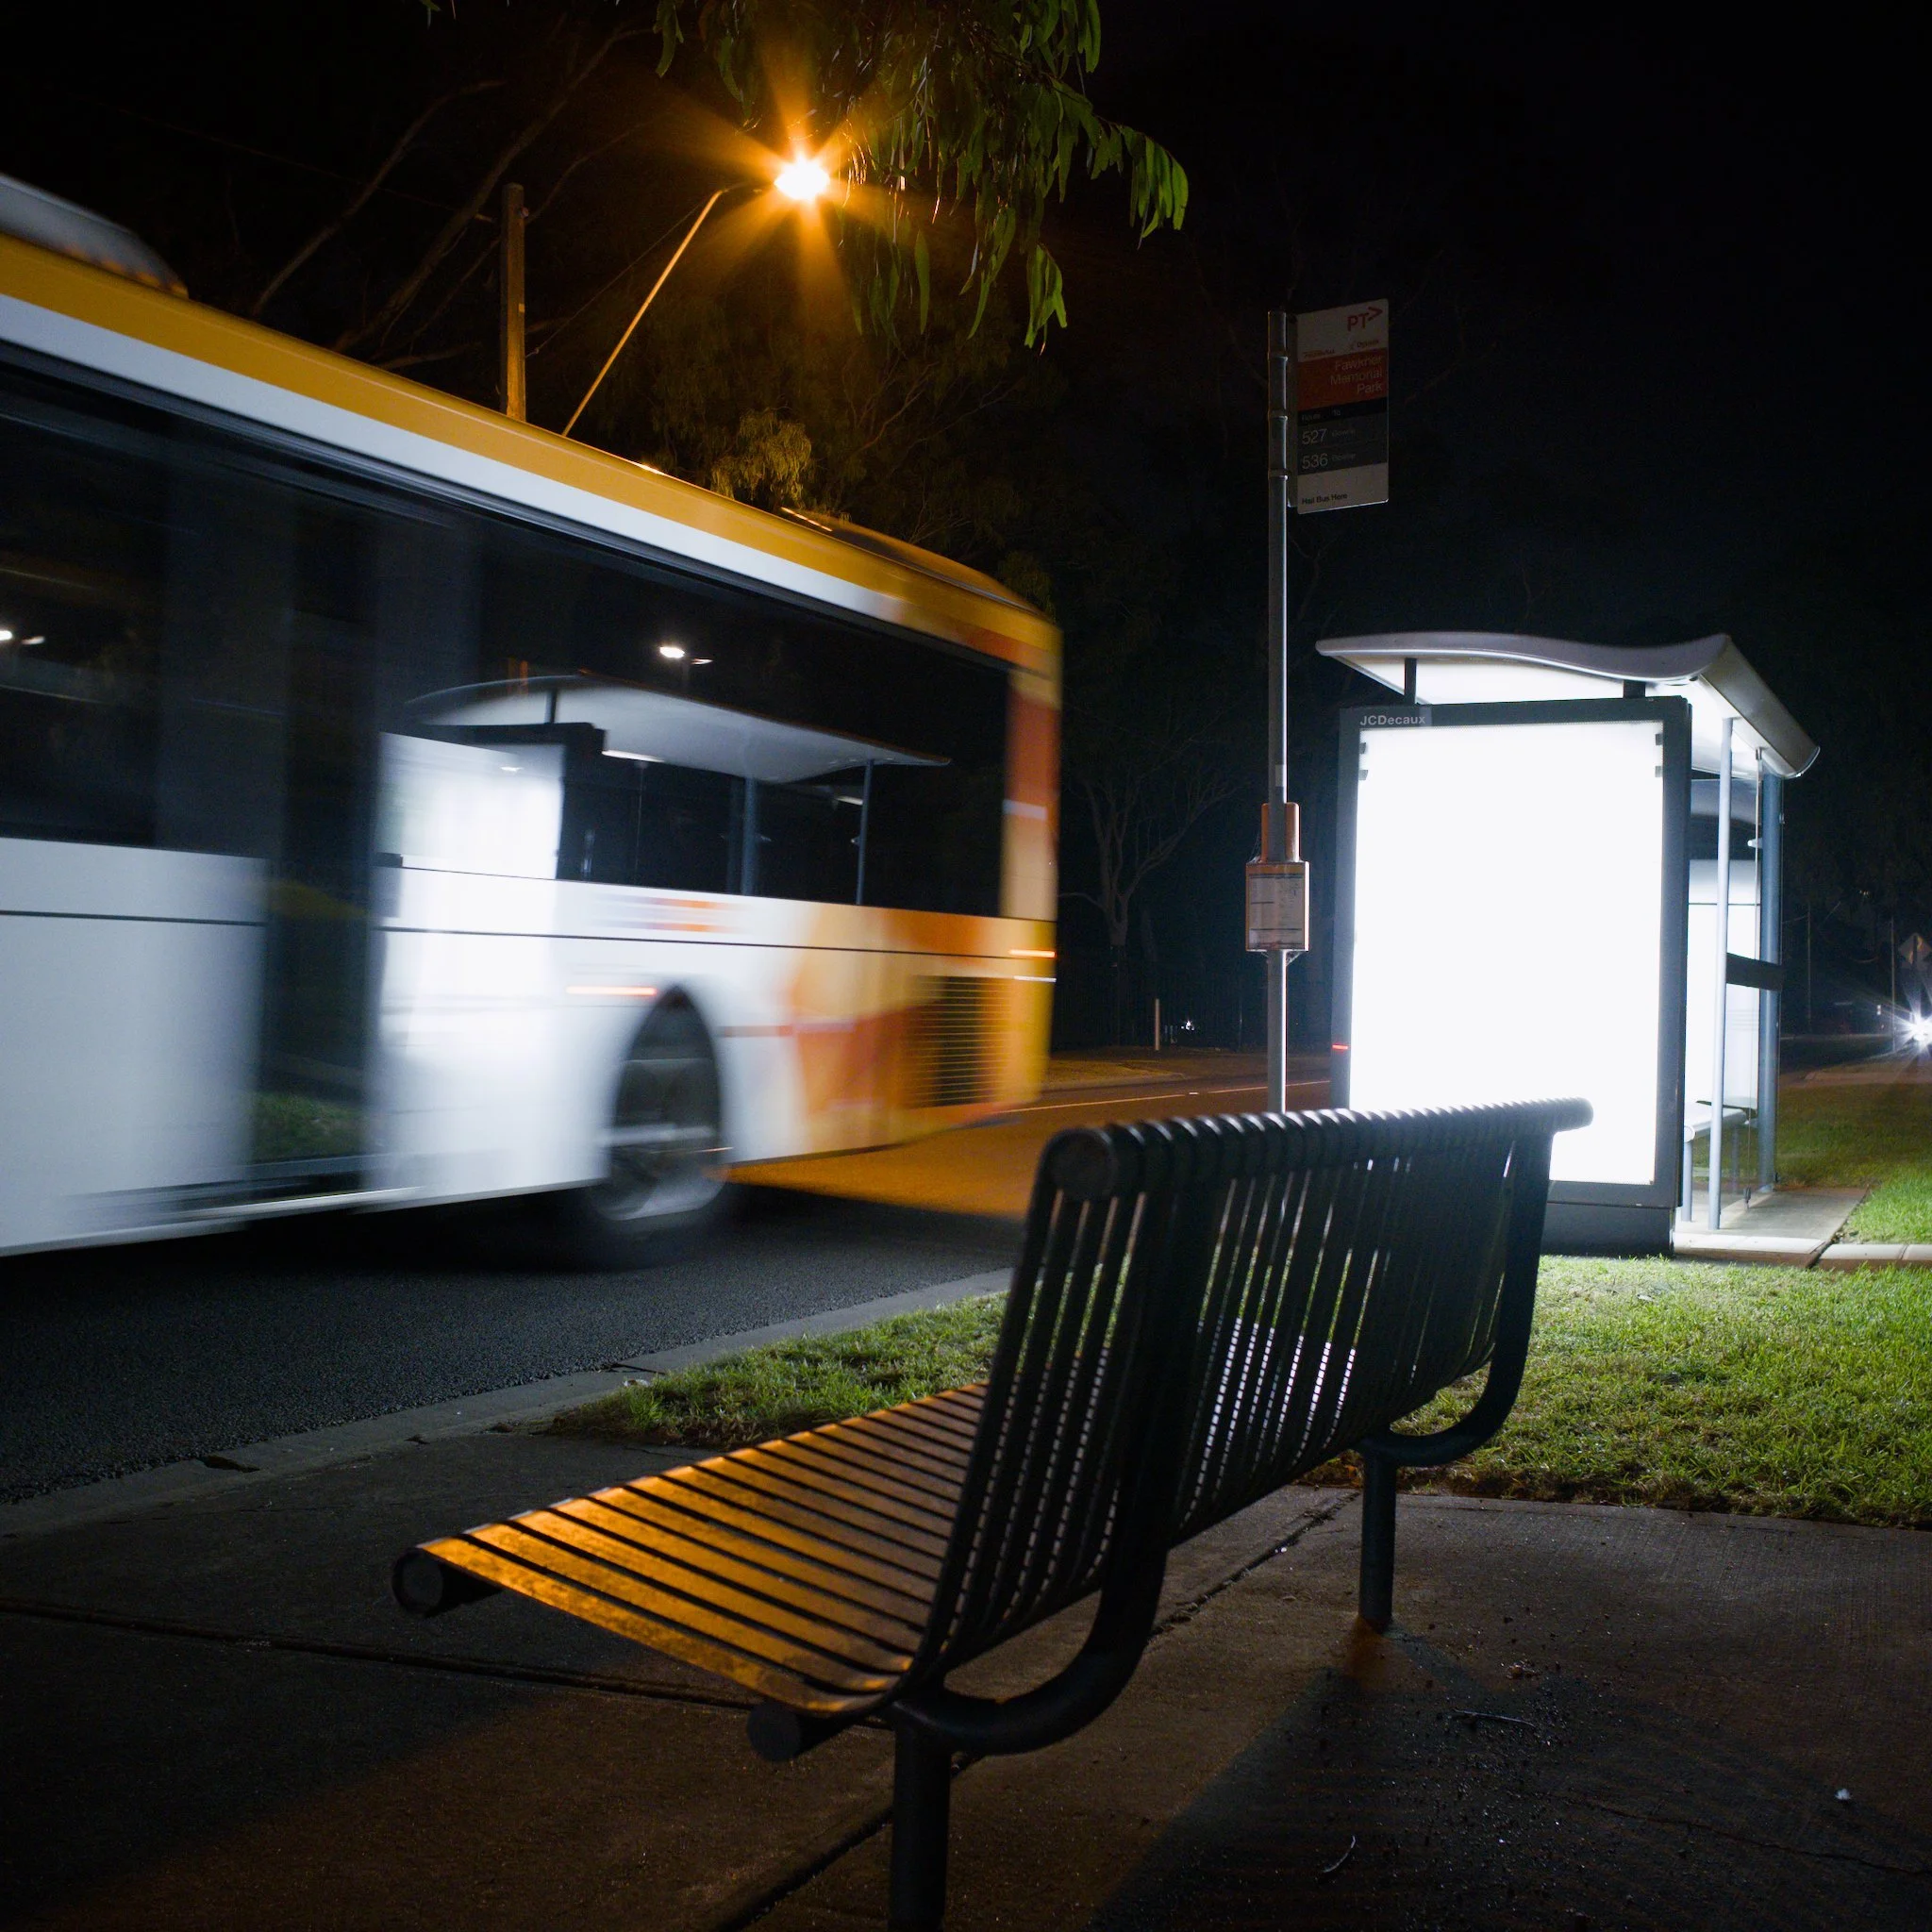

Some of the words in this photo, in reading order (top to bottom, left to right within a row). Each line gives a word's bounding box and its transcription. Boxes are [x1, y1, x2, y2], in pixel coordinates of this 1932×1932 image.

[1335, 356, 1382, 371] Fawkner
[1330, 366, 1383, 386] Memorial
[1357, 381, 1383, 395] Park
[1302, 428, 1327, 445] 527
[1302, 453, 1328, 470] 536
[1359, 715, 1426, 725] JCDecaux
